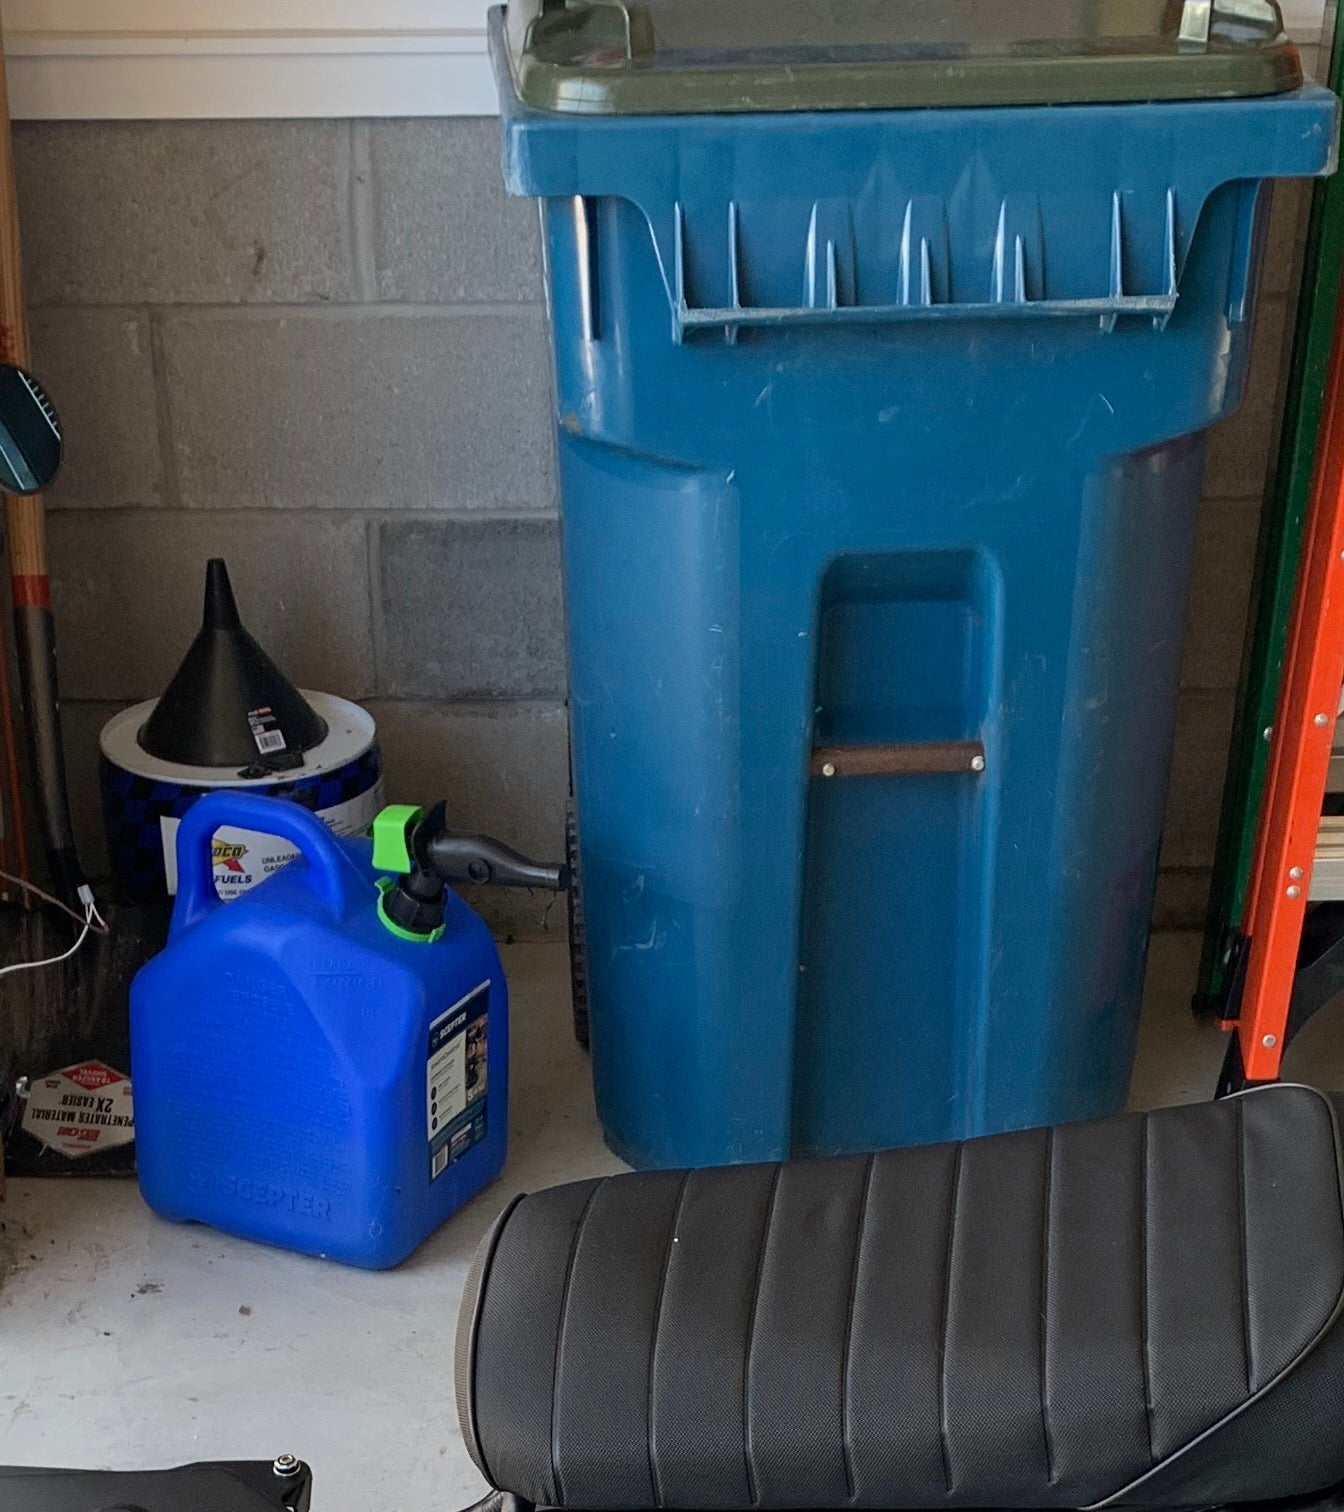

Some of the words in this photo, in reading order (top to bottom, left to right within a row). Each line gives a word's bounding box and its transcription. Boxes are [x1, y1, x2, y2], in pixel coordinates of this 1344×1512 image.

[214, 874, 253, 884] FUELS
[61, 1094, 95, 1108] EASIER
[96, 1098, 114, 1113] 2X
[31, 1108, 76, 1122] MATERIAL
[79, 1111, 135, 1127] PENETRATES
[221, 1175, 332, 1221] SCEPTER
